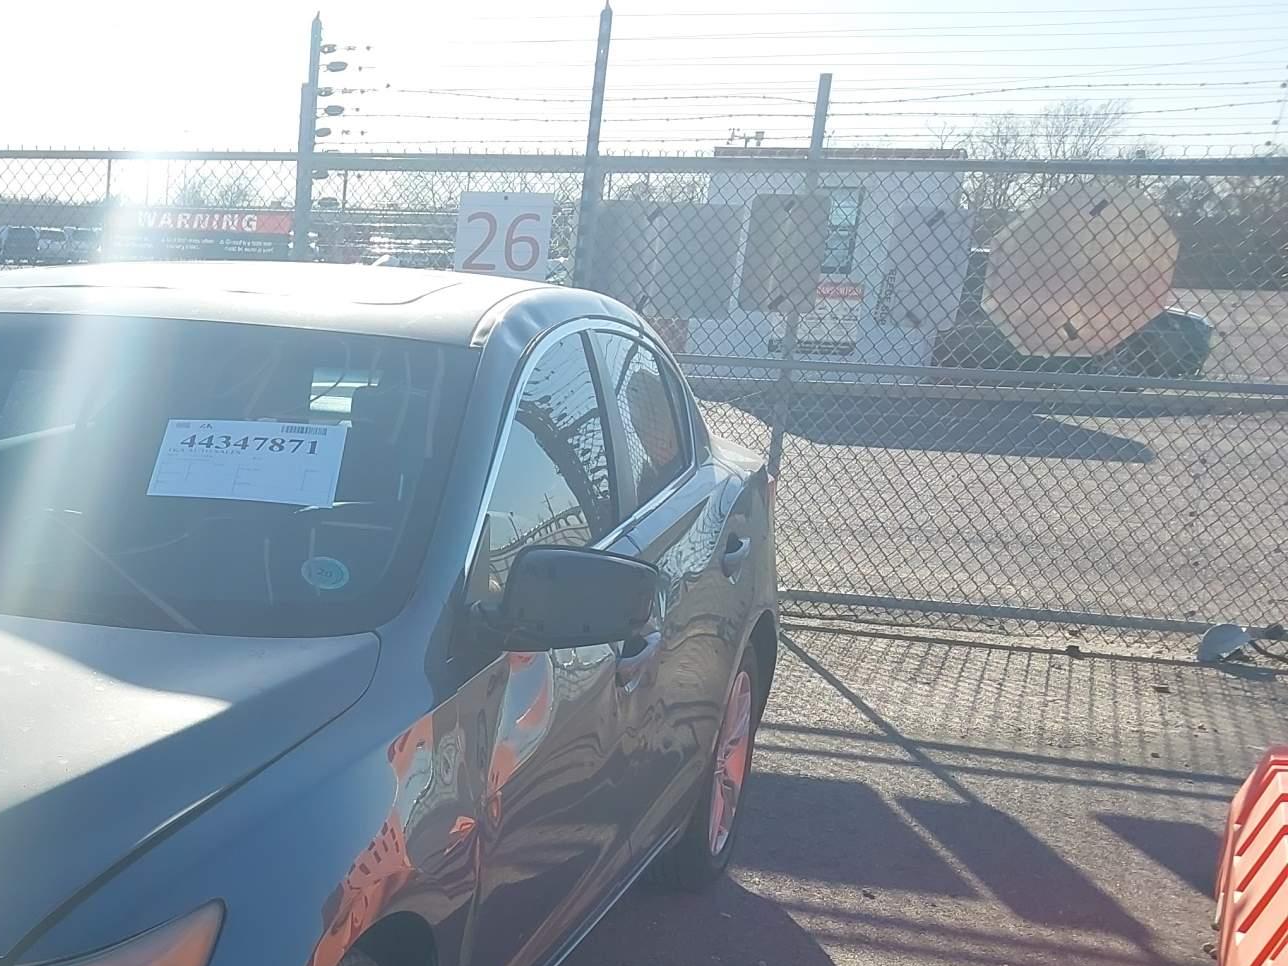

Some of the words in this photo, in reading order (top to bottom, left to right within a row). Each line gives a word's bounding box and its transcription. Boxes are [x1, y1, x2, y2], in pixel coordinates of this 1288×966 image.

[137, 210, 258, 232] WARNING
[462, 211, 540, 272] 26
[180, 434, 320, 456] 44347871
